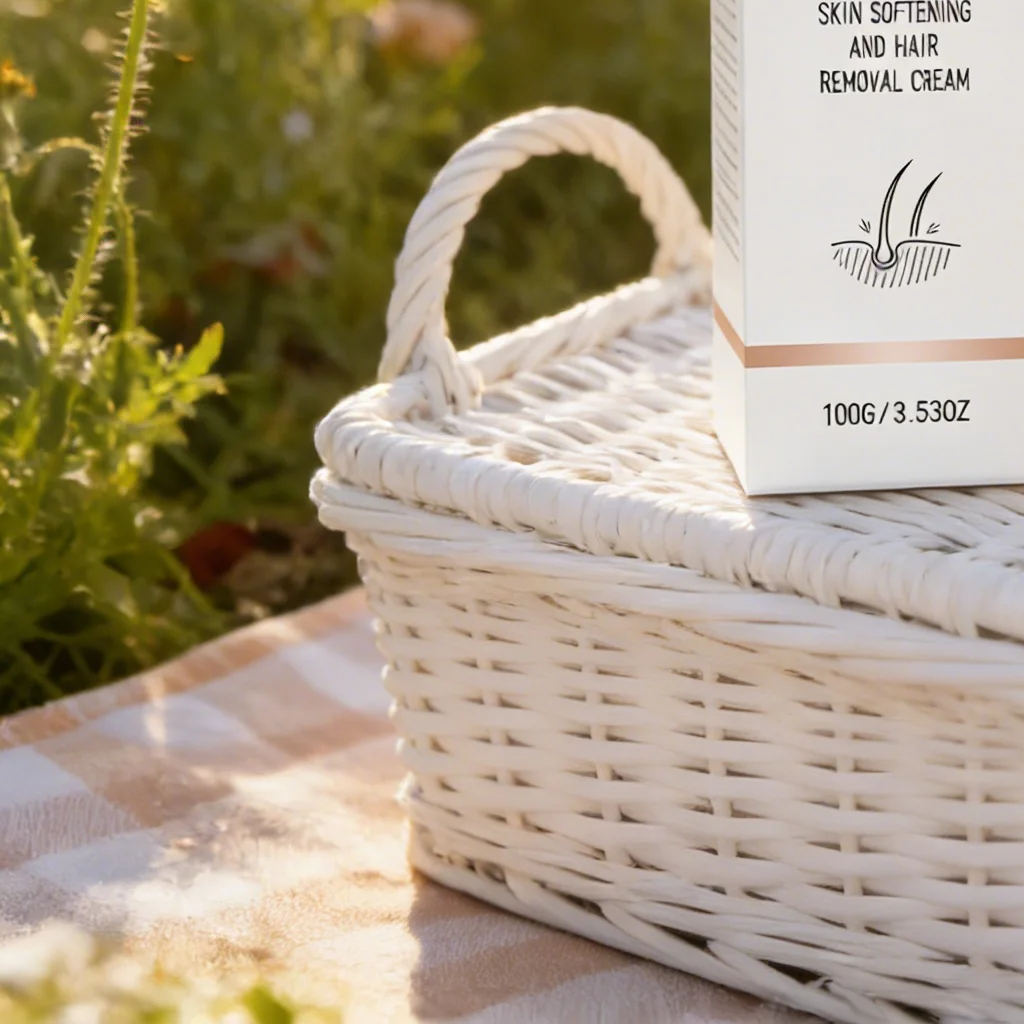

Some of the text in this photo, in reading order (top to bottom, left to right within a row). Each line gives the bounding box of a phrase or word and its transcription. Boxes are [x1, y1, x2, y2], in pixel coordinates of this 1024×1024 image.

[817, 0, 972, 26] SKIN SOFTENING
[849, 33, 939, 59] AND HAIR
[819, 67, 970, 94] REMOVAL CREAM
